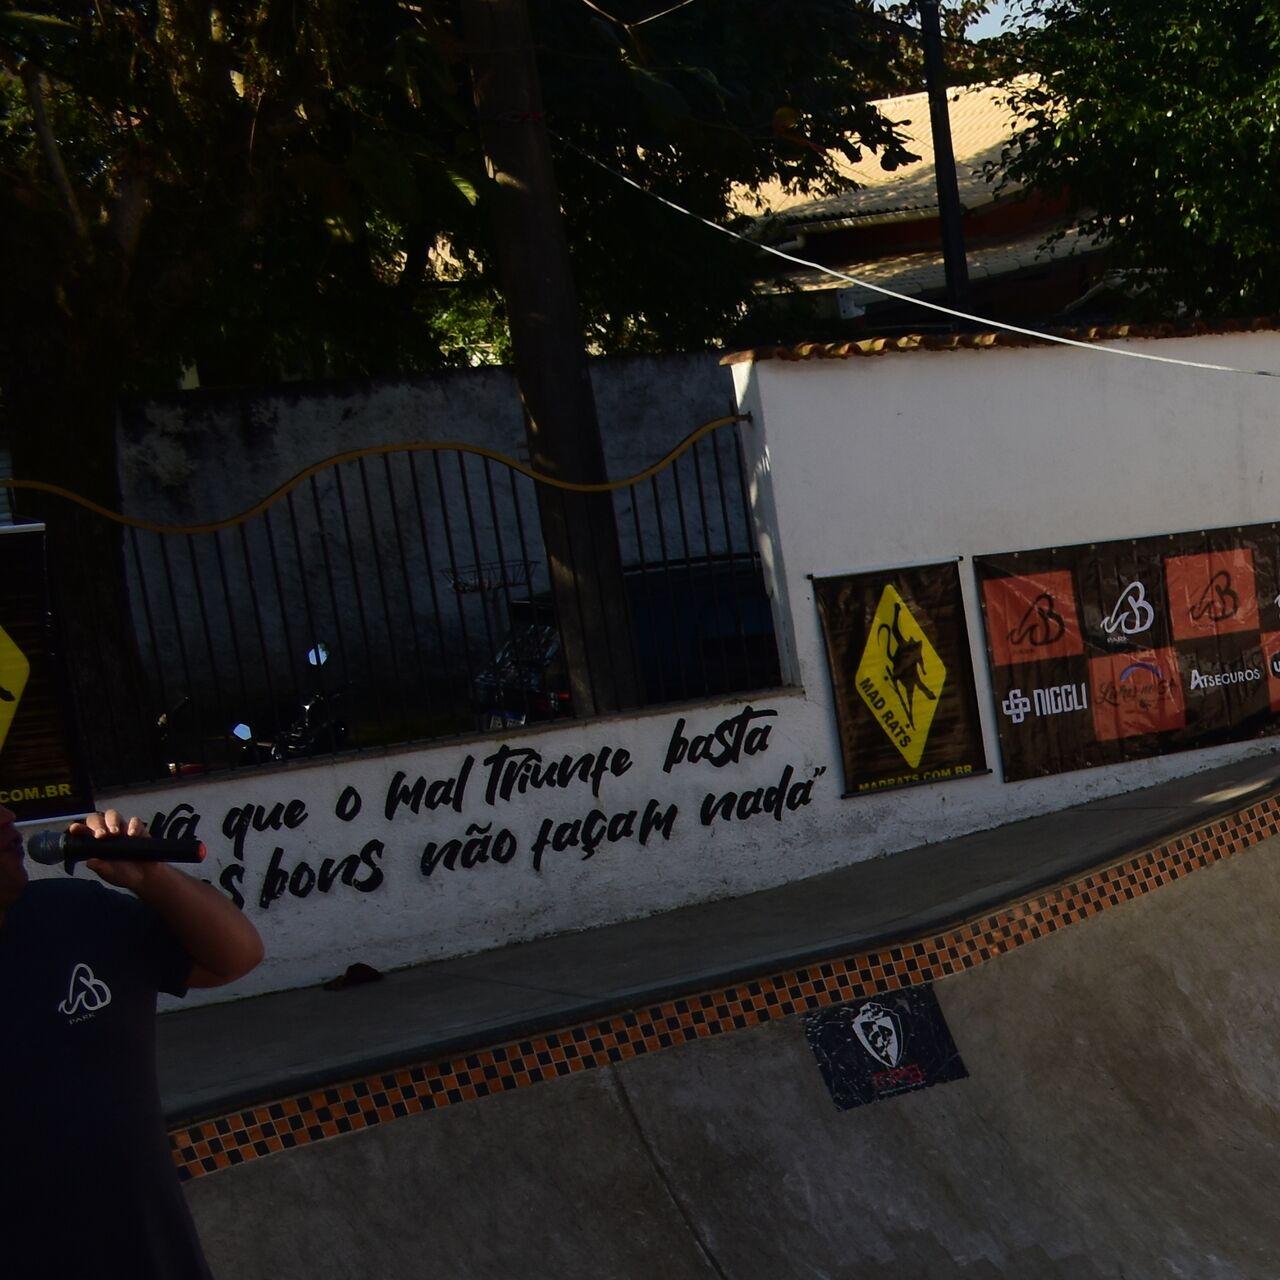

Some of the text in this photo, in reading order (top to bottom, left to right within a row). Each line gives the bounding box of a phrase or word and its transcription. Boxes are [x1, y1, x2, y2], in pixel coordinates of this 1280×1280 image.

[859, 677, 911, 748] MAD RATS
[222, 803, 309, 860] que
[336, 786, 362, 821] o
[385, 755, 474, 821] mal
[663, 706, 778, 773] basta
[259, 839, 385, 908] bons
[421, 822, 517, 876] não
[531, 799, 678, 871] façam
